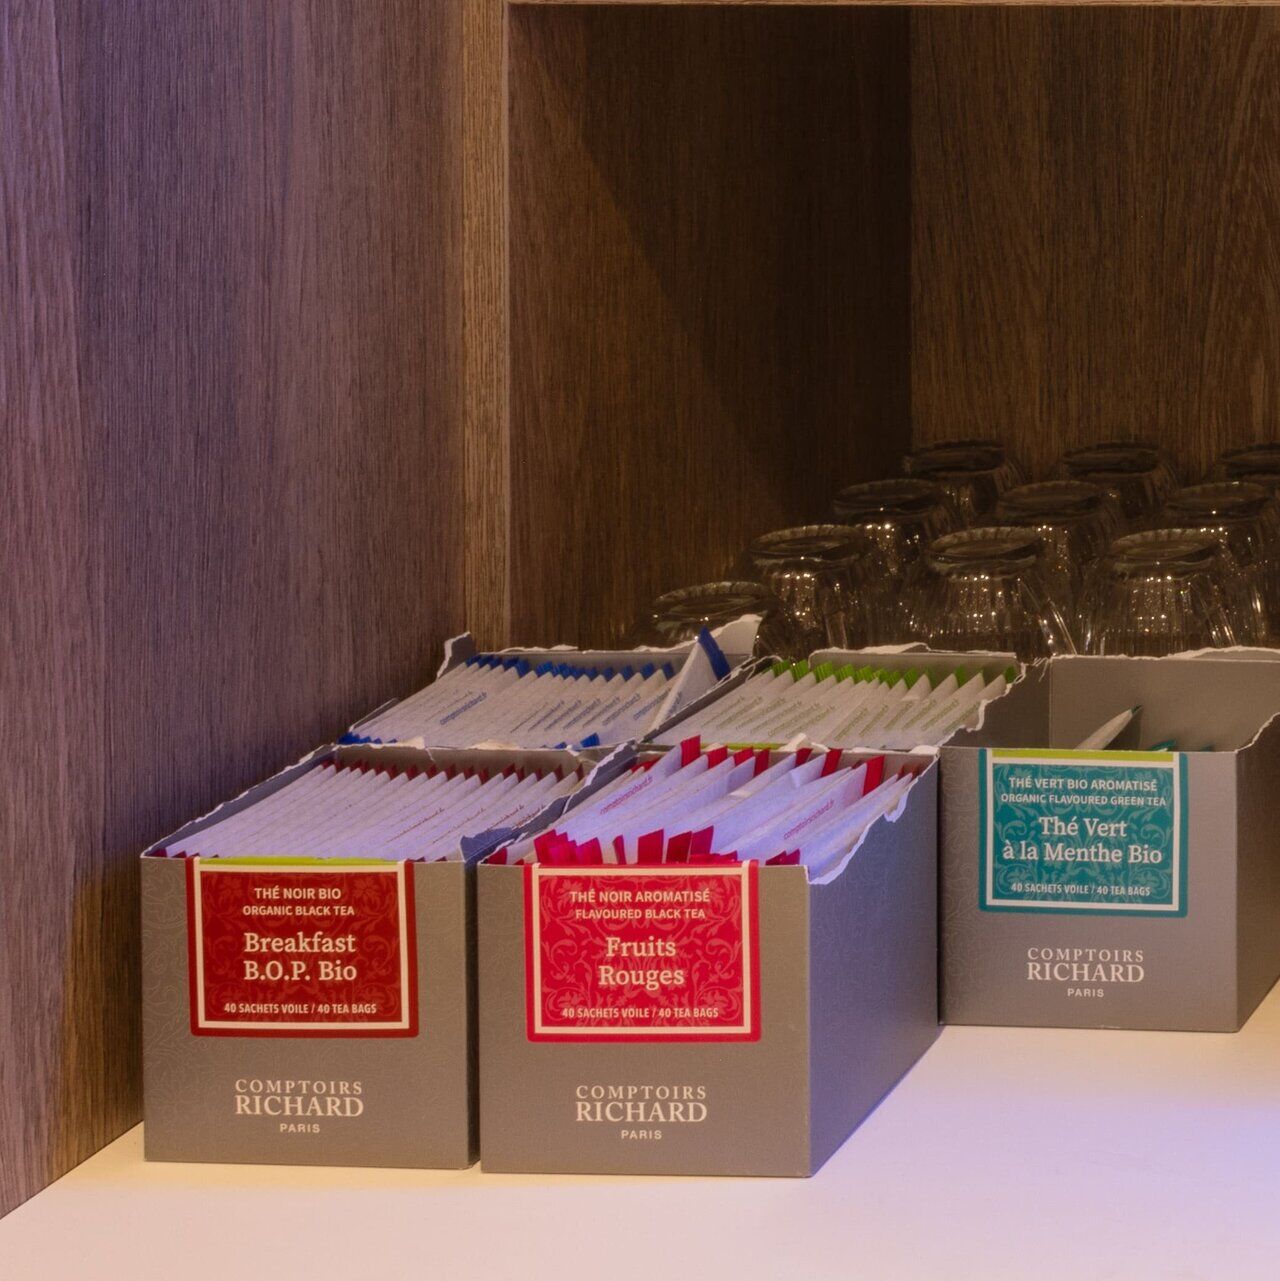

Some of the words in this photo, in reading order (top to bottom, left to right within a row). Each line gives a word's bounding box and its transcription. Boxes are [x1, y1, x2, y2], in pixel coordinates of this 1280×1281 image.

[1009, 775, 1032, 788] THÉ
[1035, 778, 1064, 789] VERT
[1067, 779, 1088, 790] BIO
[1091, 778, 1157, 791] AROMATISÉ
[1001, 793, 1046, 804] ORGANIC
[1049, 794, 1108, 805] FLAVOURED
[1110, 796, 1144, 806] GREEN
[1146, 796, 1166, 807] TEA
[1038, 816, 1079, 836] Thé
[1083, 818, 1127, 837] Vert
[1003, 839, 1015, 860] à
[1020, 840, 1039, 860] la
[1043, 842, 1123, 863] Menthe
[1128, 844, 1163, 864] Bio
[254, 885, 280, 900] THÉ
[283, 887, 315, 900] NOIR
[318, 887, 342, 900] BIO
[570, 889, 595, 903] THÉ
[599, 891, 632, 903] NOIR
[635, 888, 710, 903] AROMATISÉ
[1011, 882, 1023, 892] 40
[1025, 883, 1062, 894] SACHETS
[1064, 884, 1089, 894] VOILE
[1097, 885, 1108, 895] 40
[1110, 886, 1125, 896] TEA
[1127, 886, 1151, 897] BAGS
[242, 905, 292, 916] ORGANIC
[295, 905, 330, 916] BLACK
[333, 905, 355, 916] TEA
[575, 908, 642, 919] FLAVOURED
[645, 908, 681, 919] BLACK
[684, 908, 706, 919] TEA
[243, 931, 356, 953] Breakfast
[605, 935, 676, 957] Fruits
[1027, 947, 1144, 963] COMPTOIRS
[243, 960, 311, 981] B.O.P.
[318, 959, 357, 981] Bio
[1026, 961, 1145, 983] RICHARD
[598, 965, 685, 991] Rouges
[1067, 988, 1104, 998] PARIS
[224, 1003, 236, 1013] 40
[239, 1003, 279, 1013] SACHETS
[281, 1003, 309, 1014] VOILE
[317, 1004, 330, 1014] 40
[332, 1004, 349, 1014] TEA
[352, 1003, 377, 1014] BAGS
[562, 1008, 575, 1018] 40
[576, 1007, 619, 1018] SACHETS
[621, 1007, 649, 1018] VOILE
[658, 1008, 671, 1018] 40
[673, 1008, 691, 1018] TEA
[693, 1007, 719, 1018] BAGS
[235, 1078, 363, 1095] COMPTOIRS
[576, 1085, 706, 1100] COMPTOIRS
[234, 1094, 364, 1117] RICHARD
[576, 1101, 708, 1123] RICHARD
[280, 1123, 321, 1133] PARIS
[621, 1129, 662, 1140] PARIS
